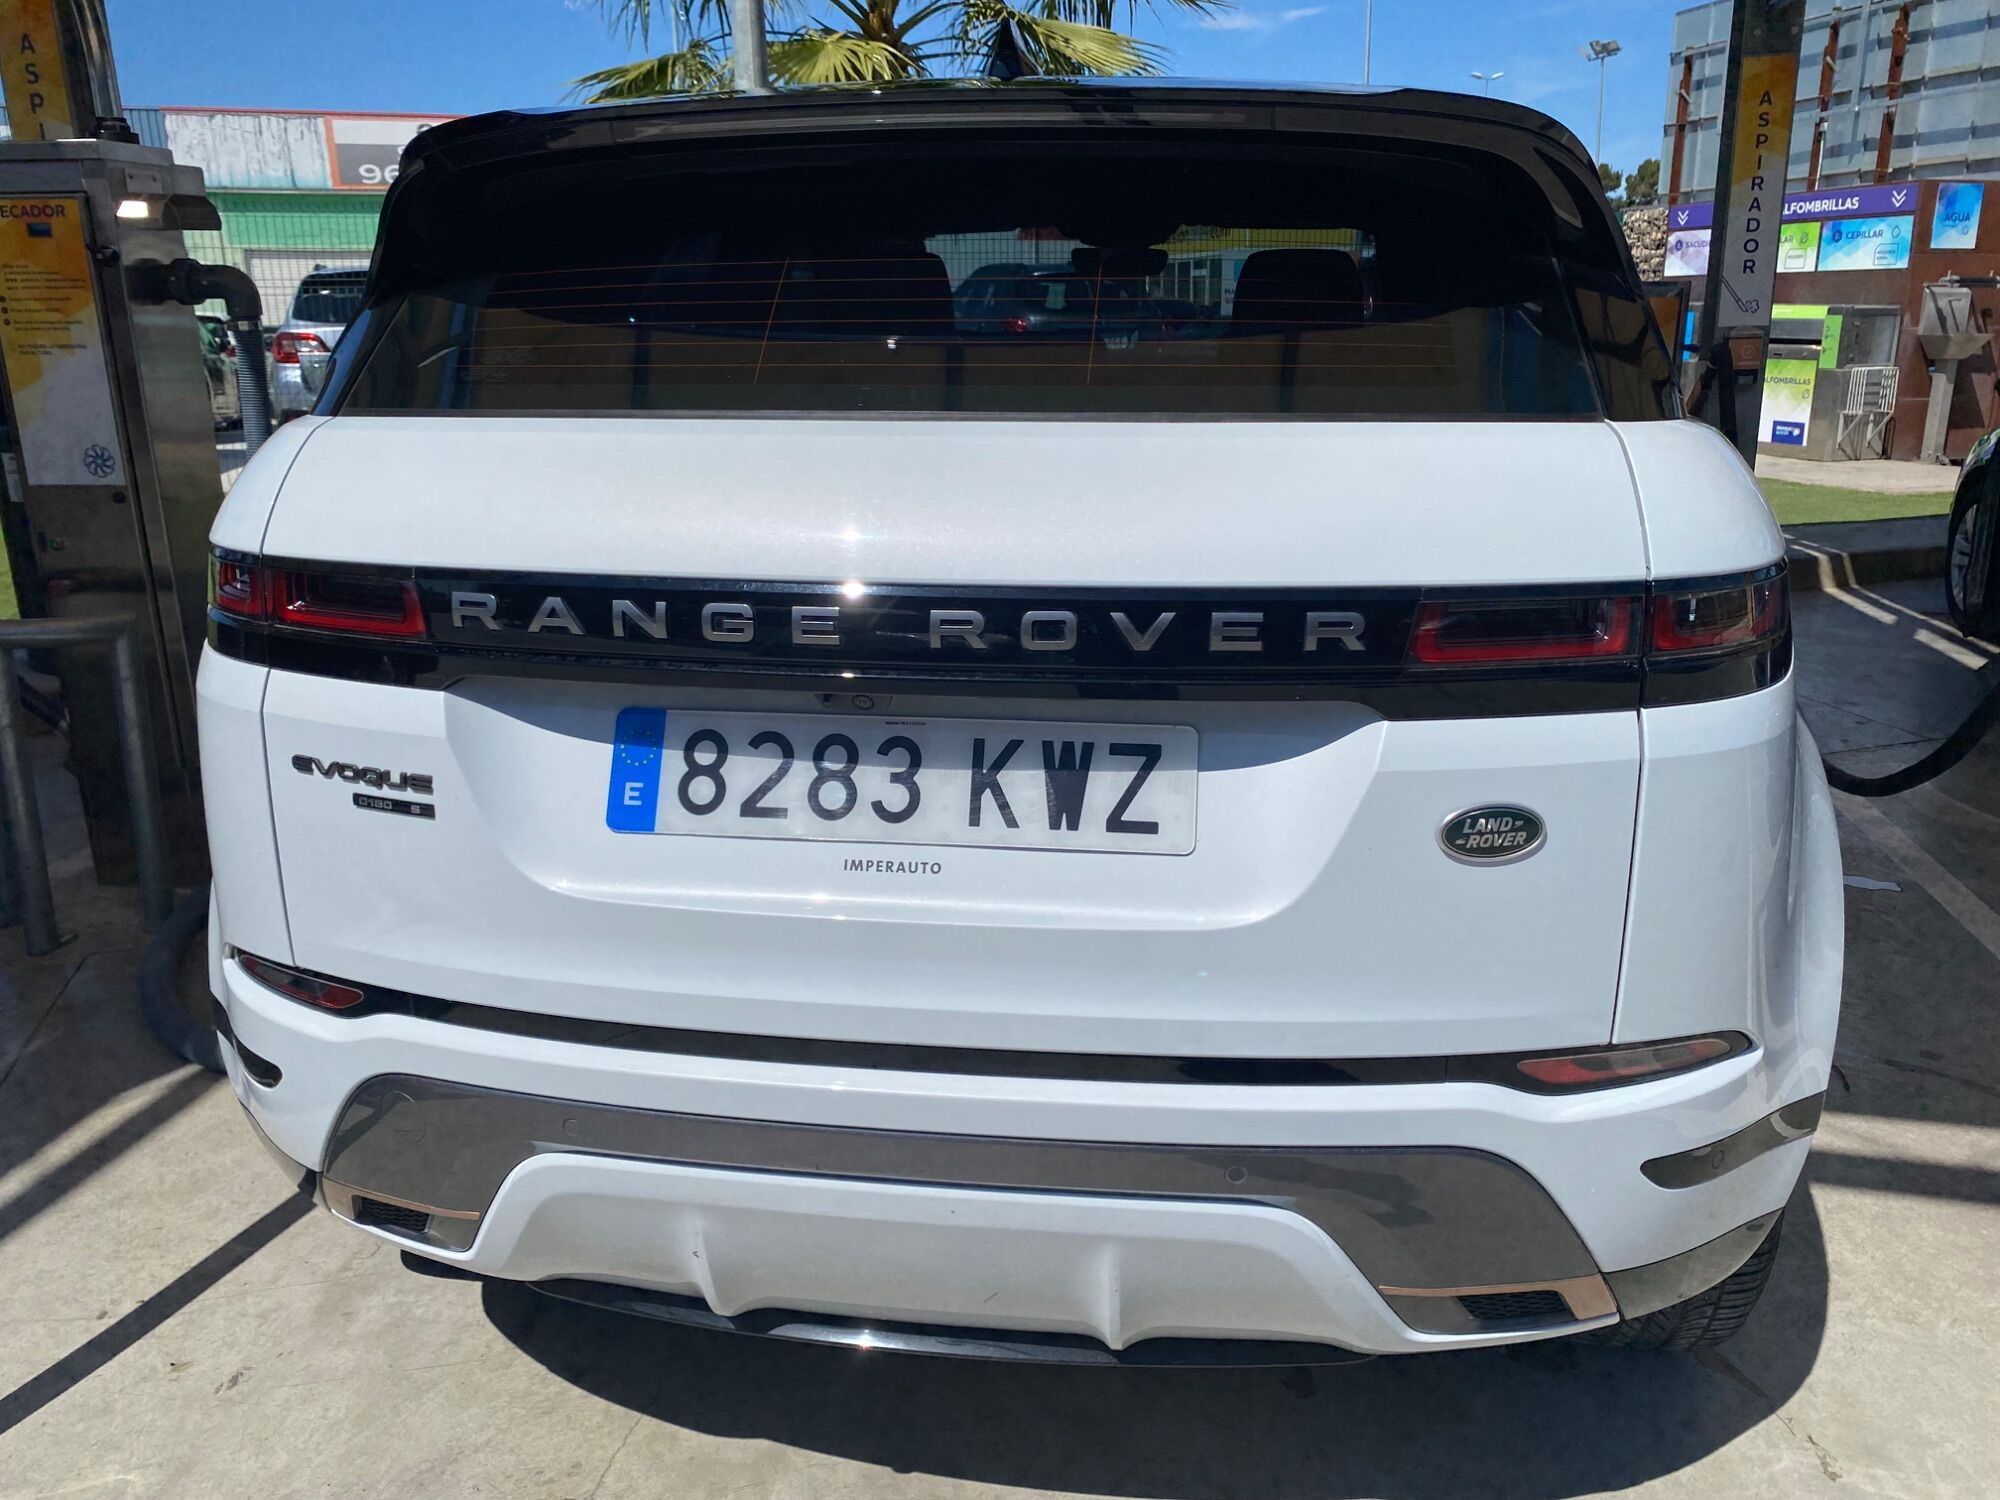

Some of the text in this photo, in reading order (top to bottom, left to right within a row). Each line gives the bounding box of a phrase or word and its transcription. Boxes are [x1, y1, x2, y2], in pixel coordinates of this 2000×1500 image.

[1742, 89, 1773, 275] ASPIRADOR
[0, 204, 66, 218] ECADOR
[1783, 196, 1860, 215] LFOMBRILLAS
[1943, 211, 1971, 223] AGUA
[1845, 229, 1884, 240] CEPILLAR
[451, 591, 1367, 652] RANGE ROVER
[292, 754, 434, 795] EVOQUE
[678, 728, 1162, 835] 8283 KWZ
[623, 782, 644, 806] E
[410, 804, 421, 814] S
[1463, 817, 1513, 833] LAND
[1465, 831, 1528, 849] ROVER
[843, 858, 942, 875] IMPERAUTO
